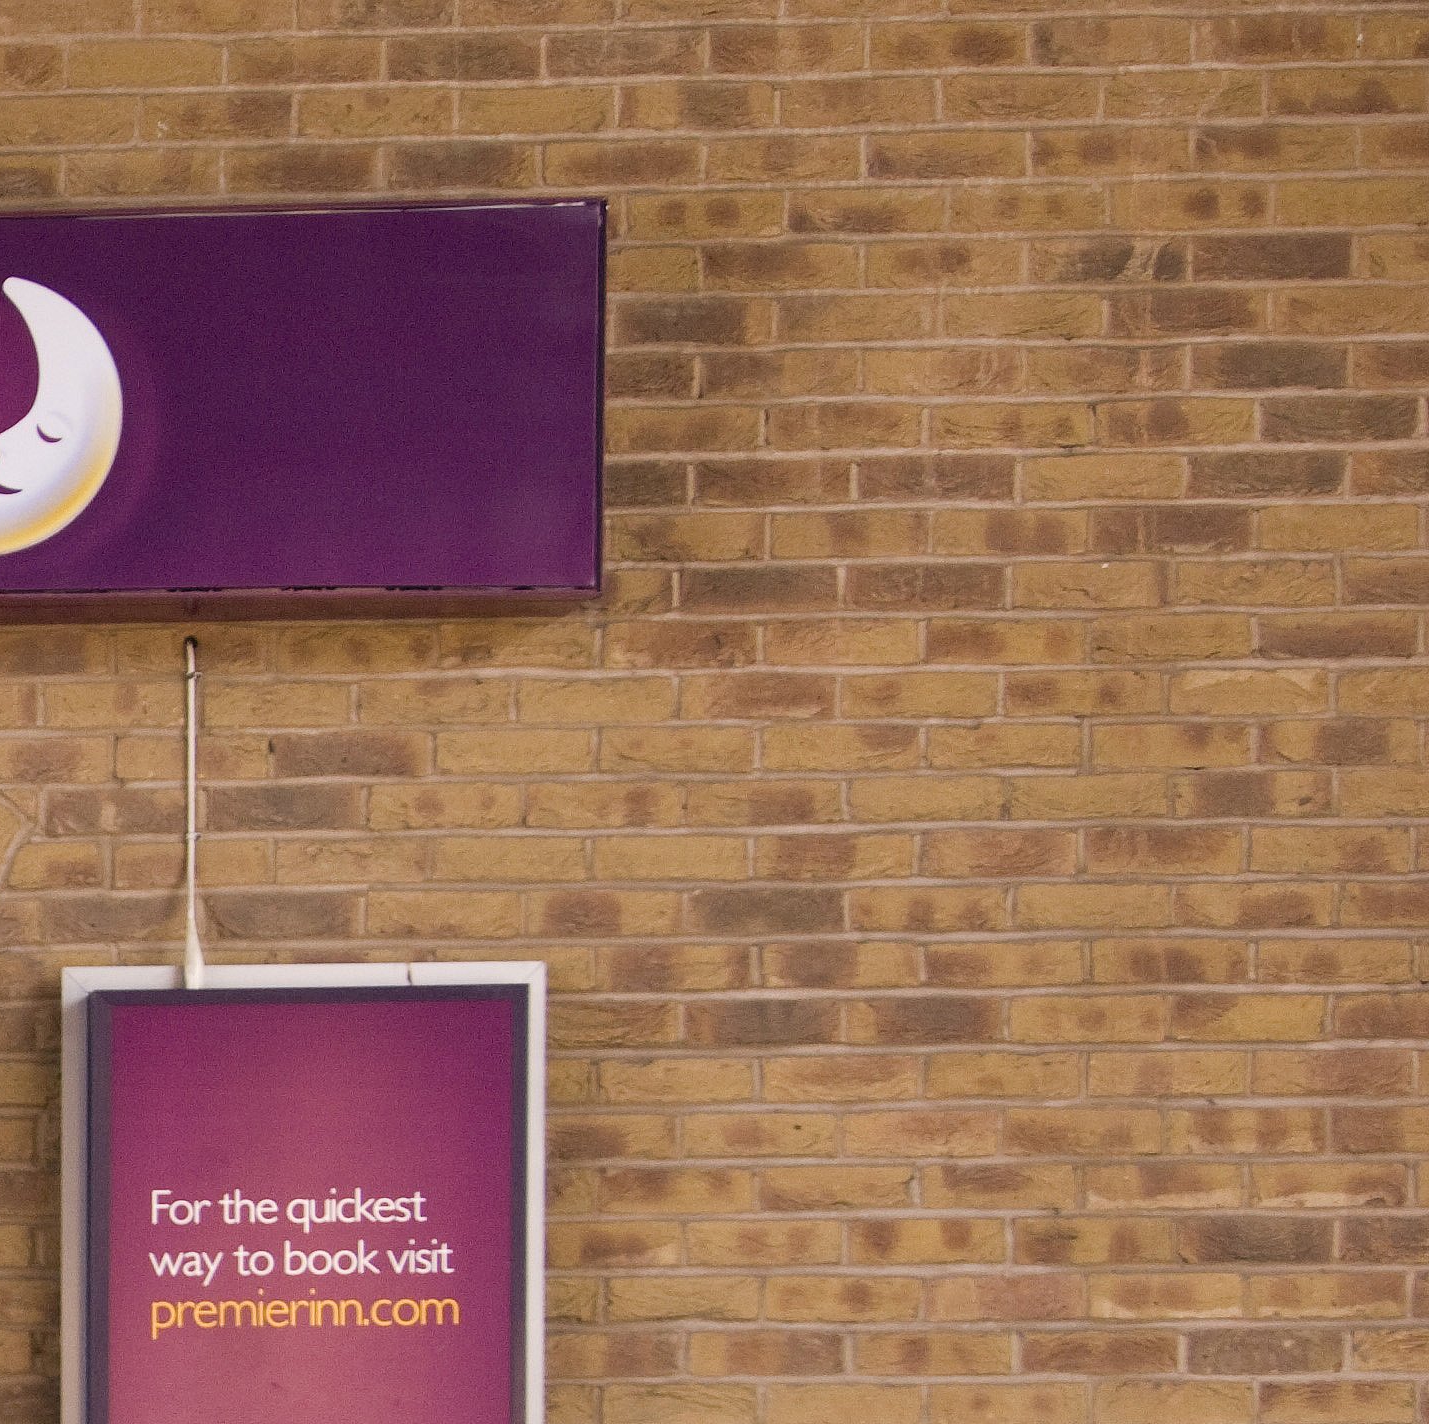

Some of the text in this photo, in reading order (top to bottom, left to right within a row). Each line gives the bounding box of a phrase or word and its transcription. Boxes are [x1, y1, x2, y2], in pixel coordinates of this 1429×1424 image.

[151, 1187, 428, 1235] For the quickest
[148, 1238, 455, 1287] way to book visit
[151, 1288, 461, 1341] premierinn.com
